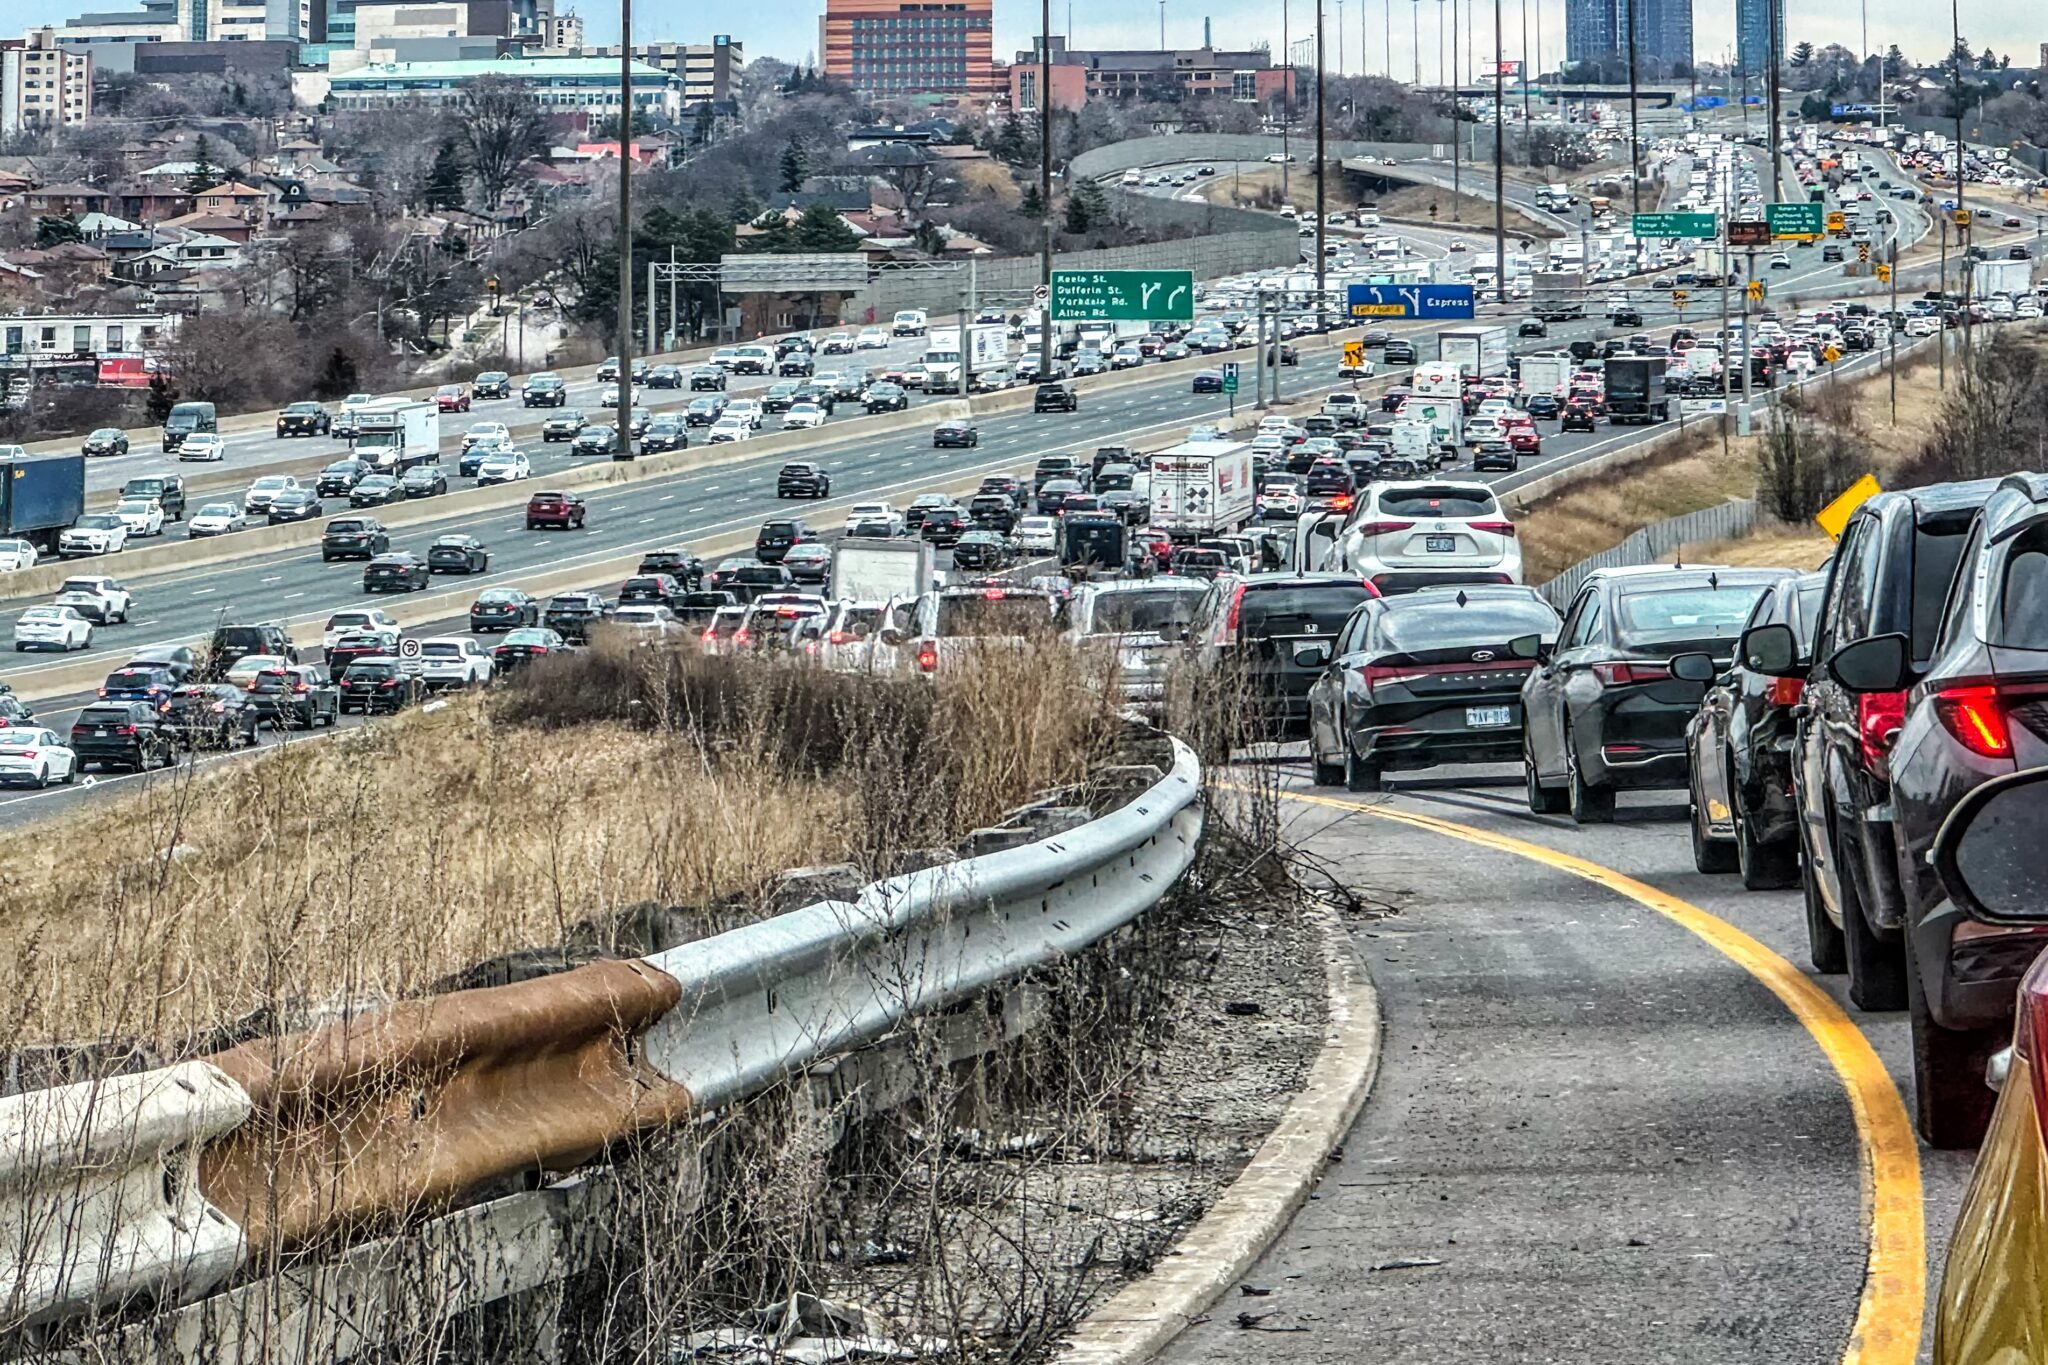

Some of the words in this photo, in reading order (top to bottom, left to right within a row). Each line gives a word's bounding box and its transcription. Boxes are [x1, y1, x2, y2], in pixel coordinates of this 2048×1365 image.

[1057, 275, 1087, 283] Keele
[1093, 275, 1107, 283] St.
[1057, 286, 1102, 294] Dufferin
[1108, 286, 1123, 294] St.
[1058, 297, 1106, 305] Yorkdale
[1111, 297, 1129, 305] Rd.
[1427, 298, 1470, 308] Express
[1057, 309, 1087, 317] Allen
[1225, 364, 1236, 377] H
